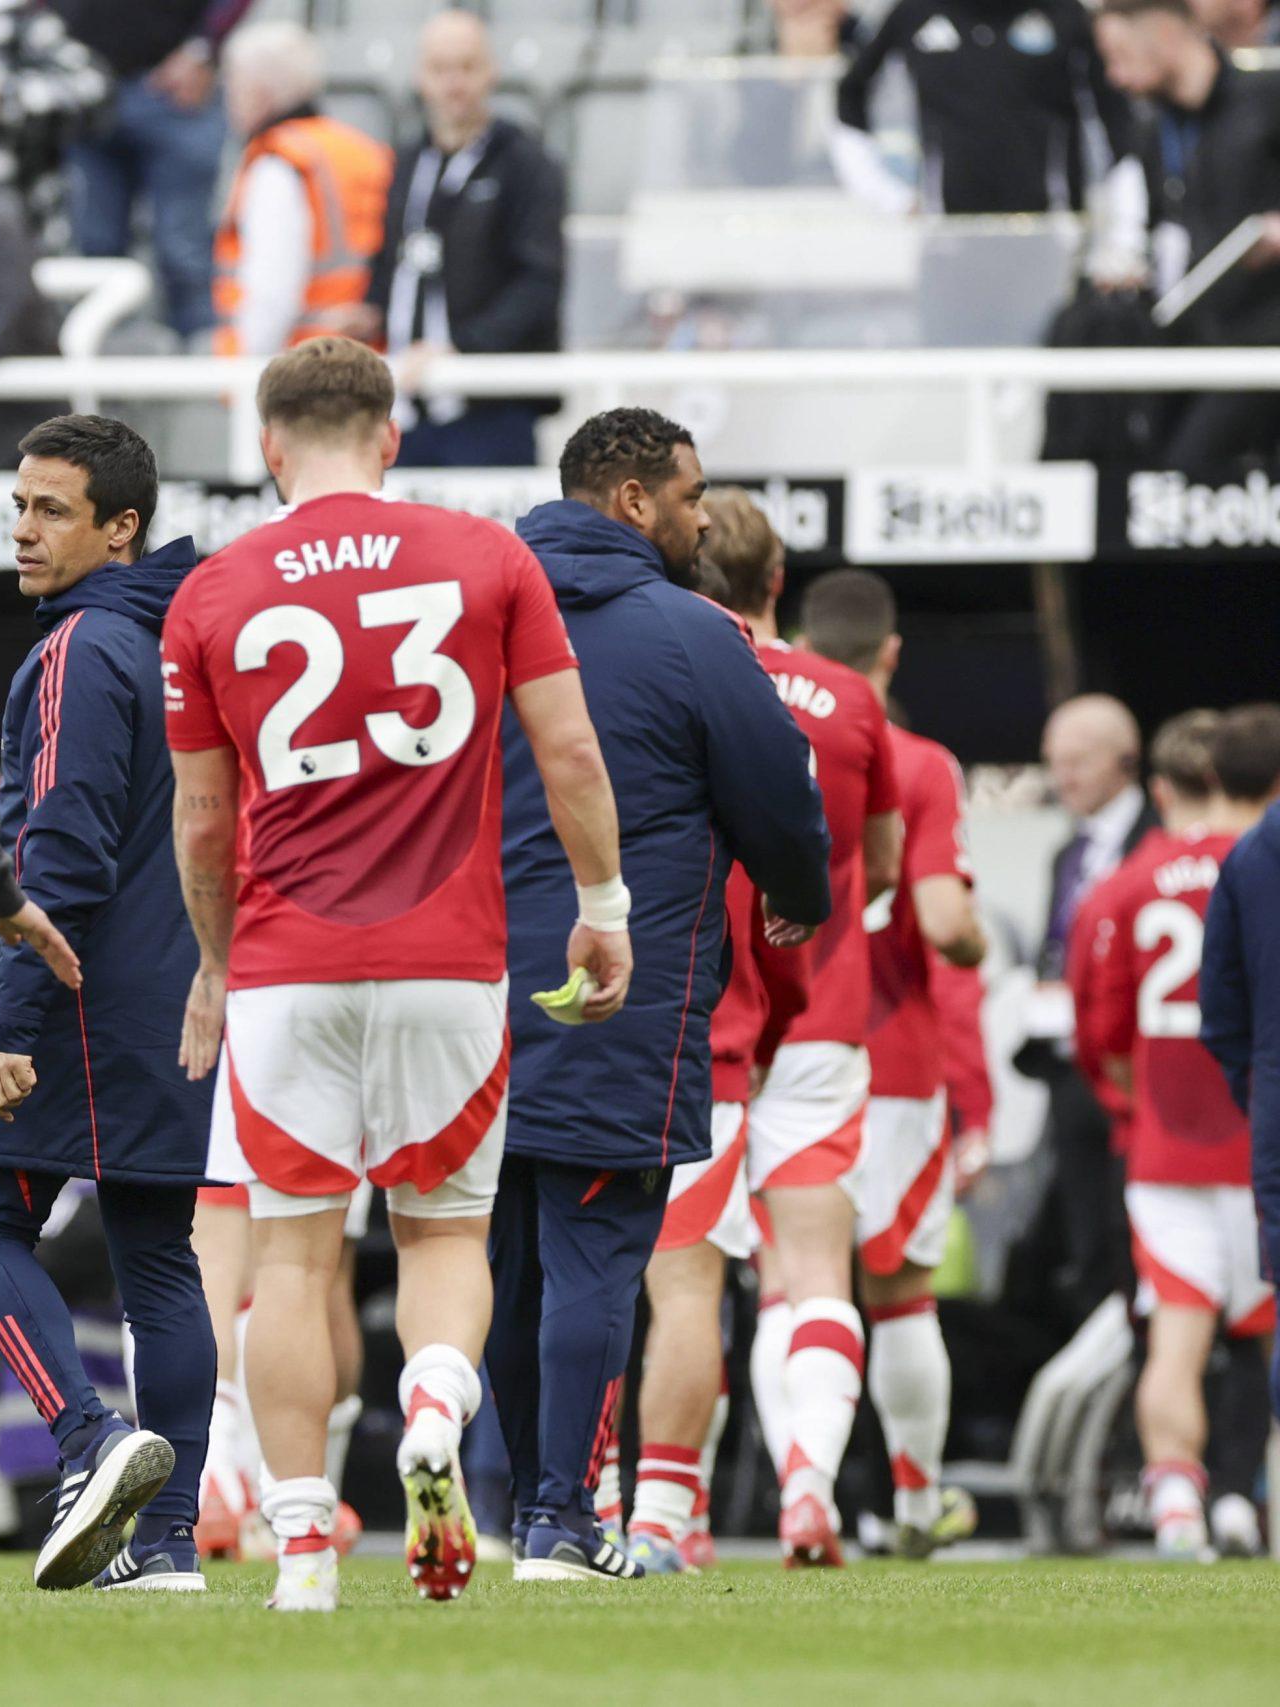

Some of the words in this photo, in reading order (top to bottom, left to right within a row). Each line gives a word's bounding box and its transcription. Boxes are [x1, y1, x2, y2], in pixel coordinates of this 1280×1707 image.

[1184, 468, 1280, 549] sel
[274, 534, 400, 584] SHAW
[233, 580, 477, 793] 23
